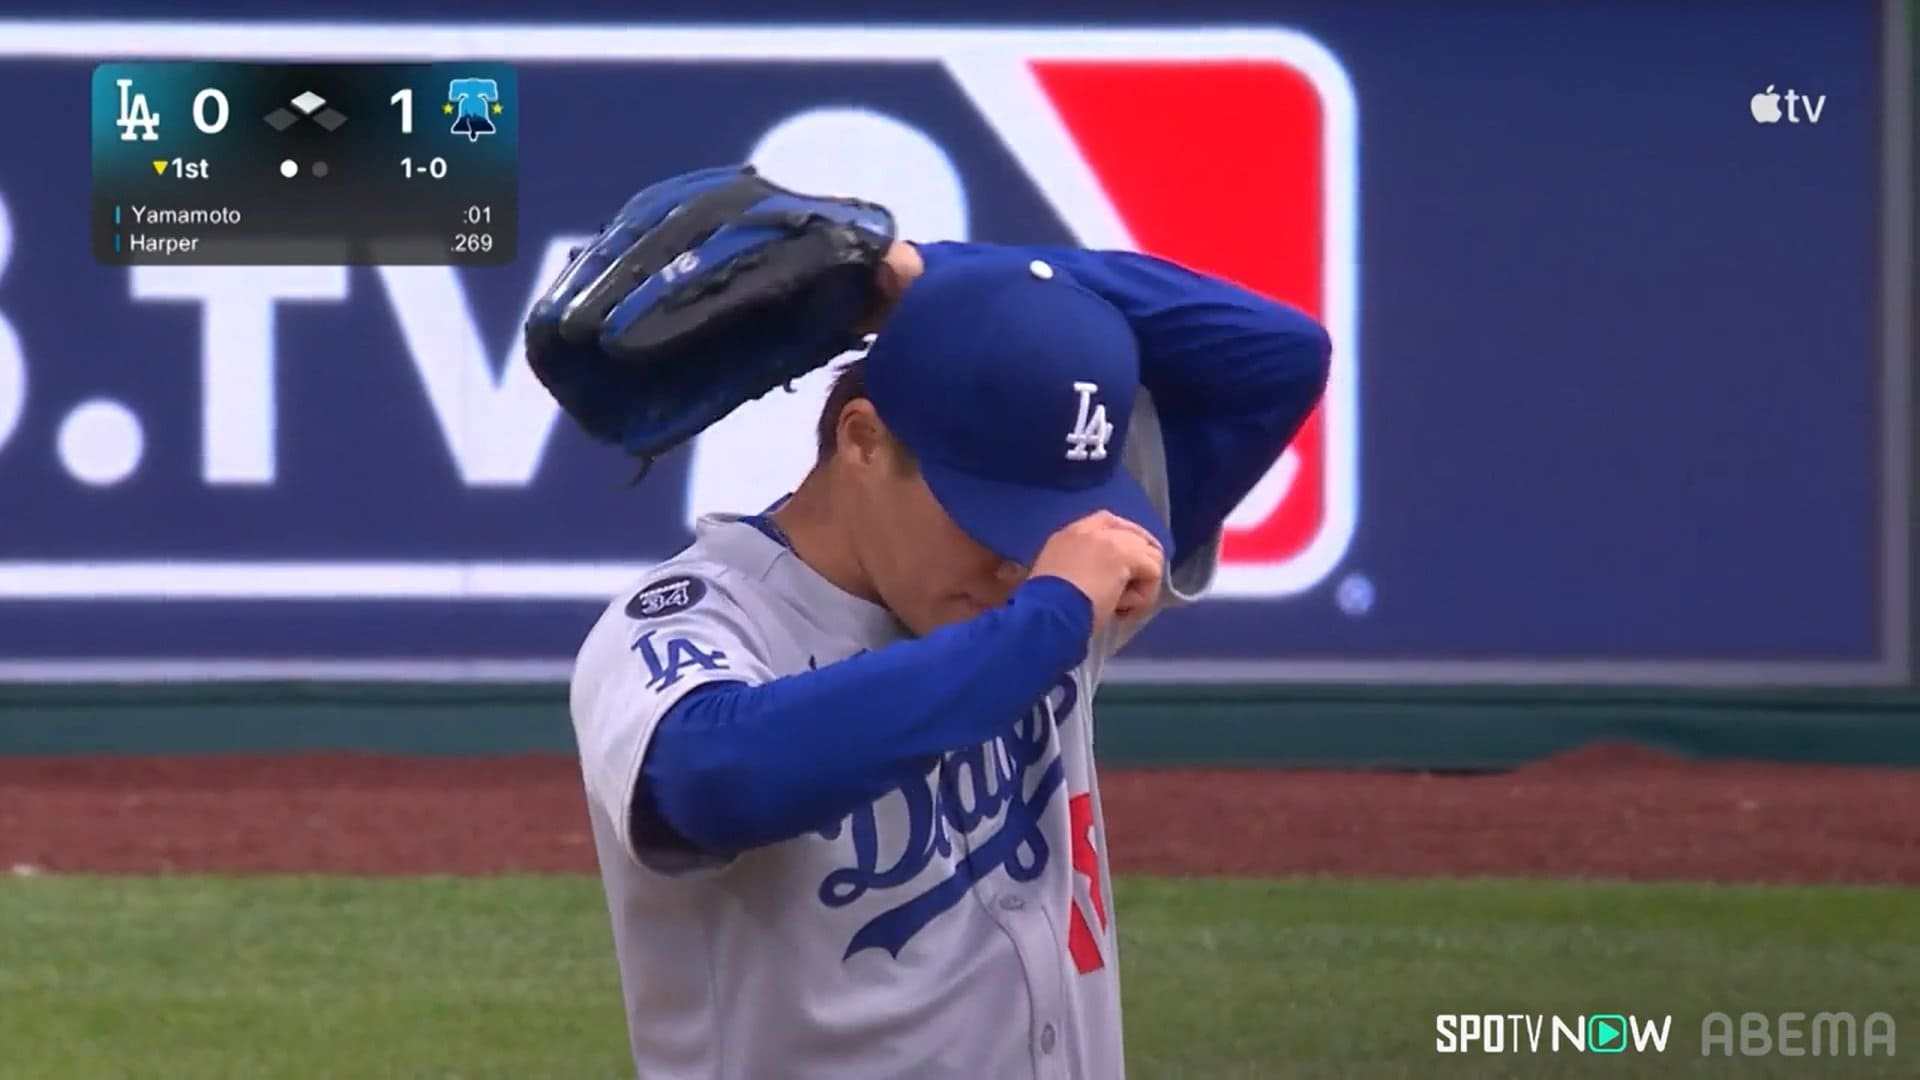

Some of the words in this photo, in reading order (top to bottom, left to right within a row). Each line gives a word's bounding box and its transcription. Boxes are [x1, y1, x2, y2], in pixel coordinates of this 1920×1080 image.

[0, 188, 600, 487] .TV
[1065, 381, 1114, 460] LA
[631, 630, 730, 693] LA
